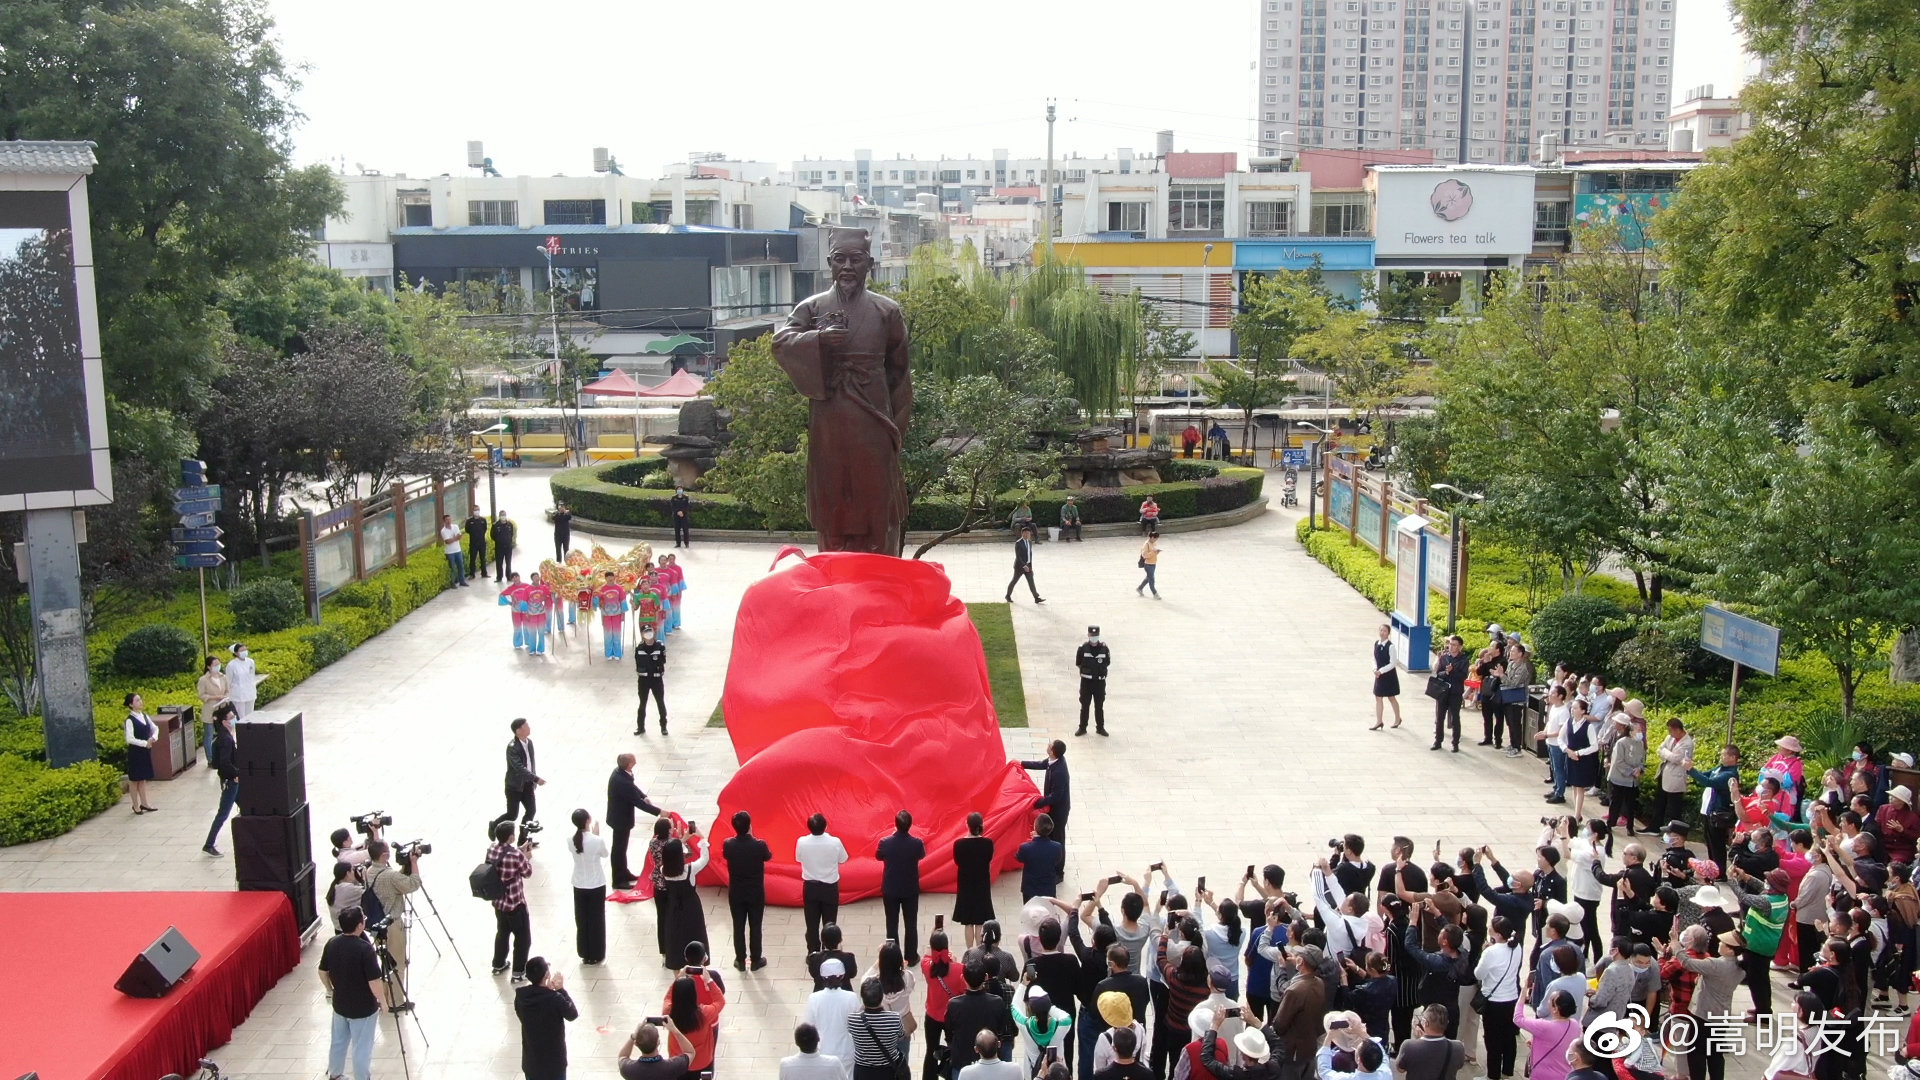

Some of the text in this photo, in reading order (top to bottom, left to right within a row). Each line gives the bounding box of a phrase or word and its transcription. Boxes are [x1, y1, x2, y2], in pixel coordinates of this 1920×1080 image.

[1404, 231, 1496, 244] Flowers tea talk
[562, 247, 599, 255] TRIES
